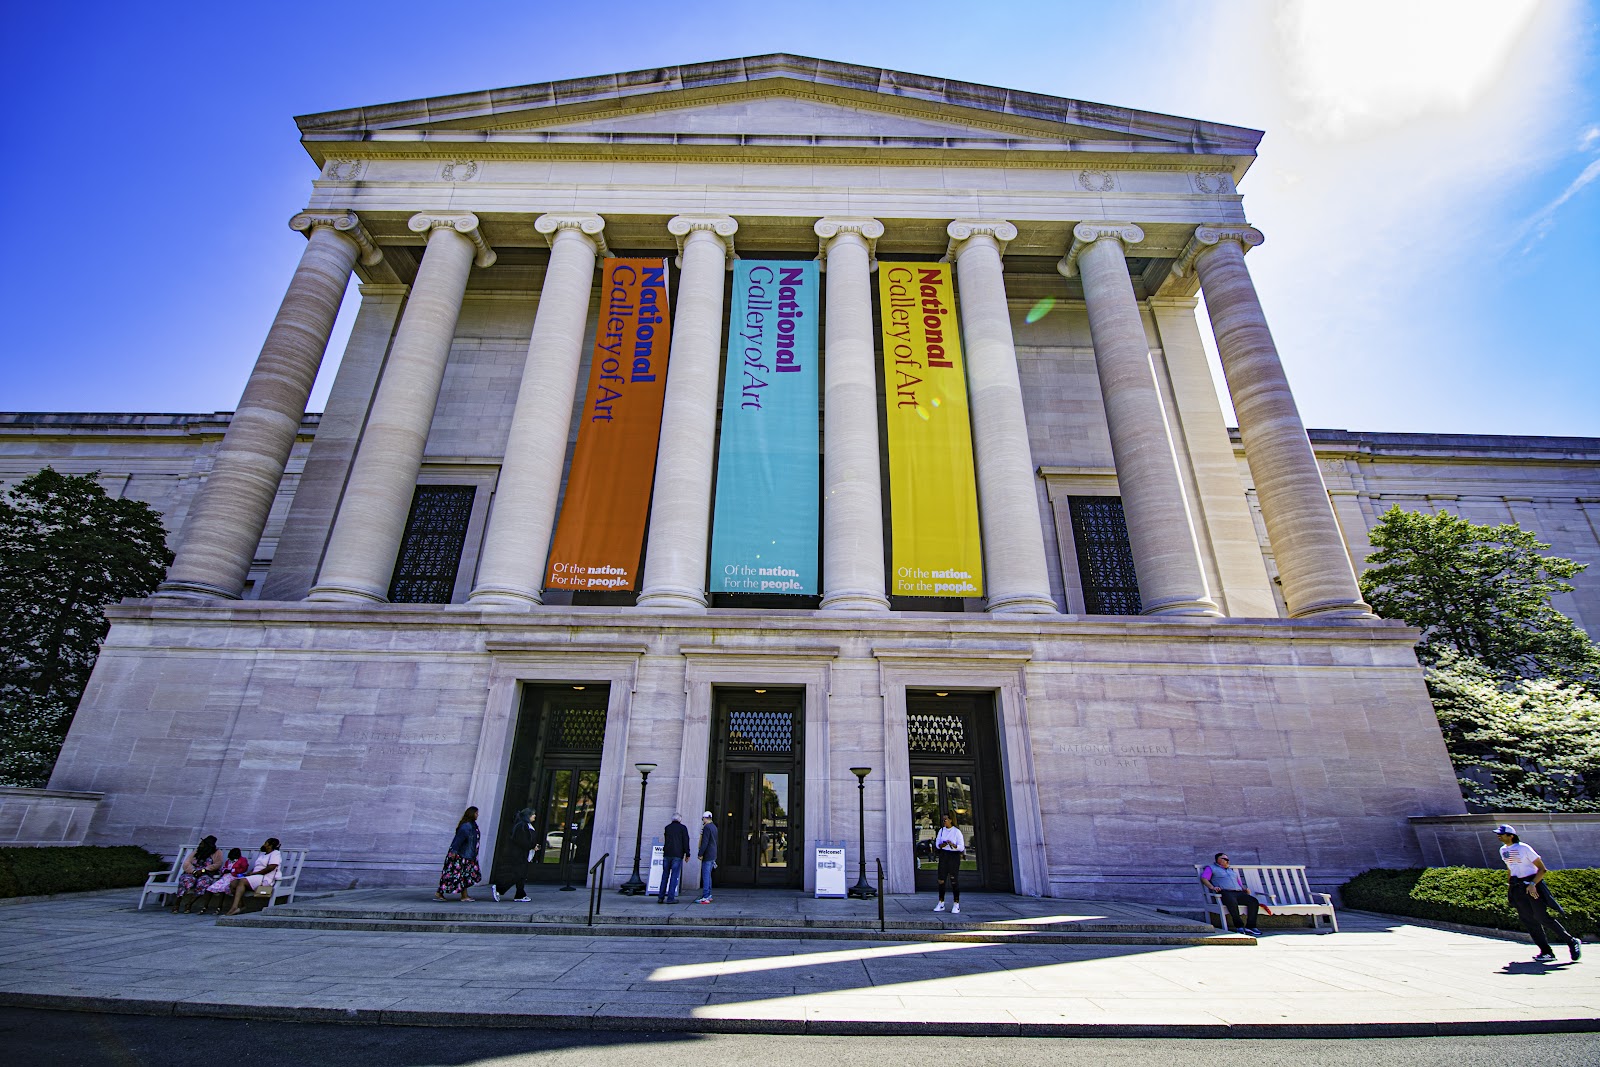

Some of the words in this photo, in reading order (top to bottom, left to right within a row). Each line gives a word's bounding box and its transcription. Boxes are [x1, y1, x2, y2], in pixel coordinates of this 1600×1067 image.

[598, 265, 637, 356] Gallery
[740, 266, 774, 345] Gallery
[886, 267, 915, 342] Gallery
[631, 267, 665, 383] National
[776, 267, 803, 373] National
[918, 268, 953, 368] National
[745, 347, 770, 373] of
[894, 344, 922, 369] of
[600, 358, 625, 384] of
[741, 370, 768, 411] Art
[895, 369, 923, 409] Art
[592, 384, 623, 423] Art
[551, 573, 568, 584] For
[570, 575, 586, 585] the
[587, 577, 629, 588] people.
[553, 562, 569, 573] Of
[570, 563, 586, 574] the
[587, 564, 628, 576] nation.
[724, 564, 740, 575] Of
[741, 565, 757, 576] the
[758, 566, 799, 577] nation.
[897, 566, 912, 578] Of
[913, 567, 929, 578] the
[931, 568, 972, 579] nation.
[724, 577, 741, 588] For
[743, 577, 759, 588] the
[761, 578, 803, 591] people.
[898, 579, 914, 590] For
[916, 580, 932, 591] the
[934, 581, 977, 593] people.
[353, 732, 401, 740] UNITED
[405, 733, 447, 741] STATES
[1059, 744, 1112, 753] NATIONAL
[1120, 745, 1169, 754] GALLERY
[380, 746, 433, 755] AMERICA
[1094, 759, 1107, 767] OF
[1117, 759, 1137, 767] ART
